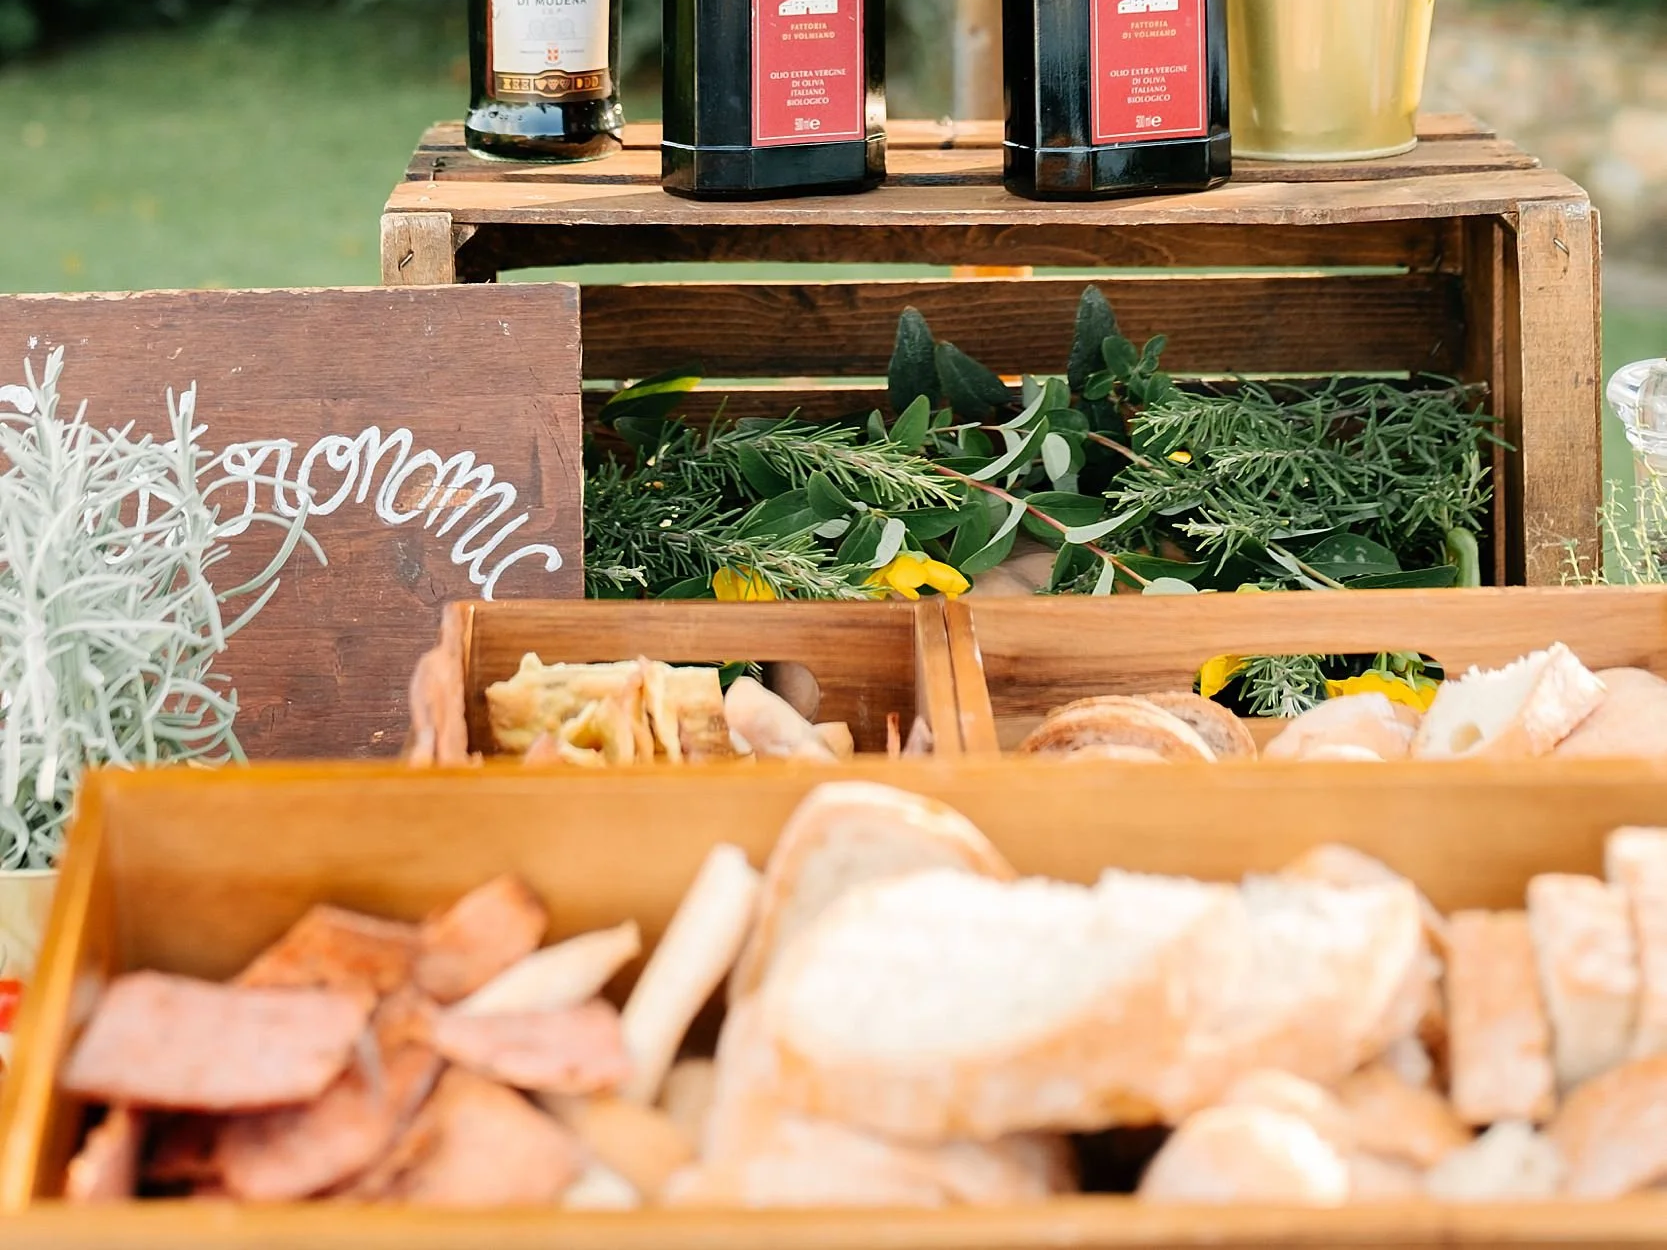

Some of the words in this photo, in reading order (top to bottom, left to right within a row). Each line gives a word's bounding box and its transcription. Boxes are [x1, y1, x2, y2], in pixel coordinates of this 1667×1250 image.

[790, 22, 828, 31] FATTORIA
[1130, 20, 1168, 29] FATTORIA
[782, 33, 791, 41] DI
[770, 71, 789, 80] OLIO
[791, 70, 813, 78] EXTRA
[815, 68, 846, 77] VERGINE
[1110, 69, 1129, 78] OLIO
[1131, 67, 1155, 76] EXTRA
[1156, 65, 1188, 74] VERGINE
[802, 79, 825, 87] OLIVA
[1142, 77, 1166, 85] OLIVA
[791, 88, 826, 97] ITALIANO
[1131, 86, 1167, 94] ITALIANO
[786, 97, 830, 107] BIOLOGICO
[1127, 94, 1171, 104] BIOLOGICO
